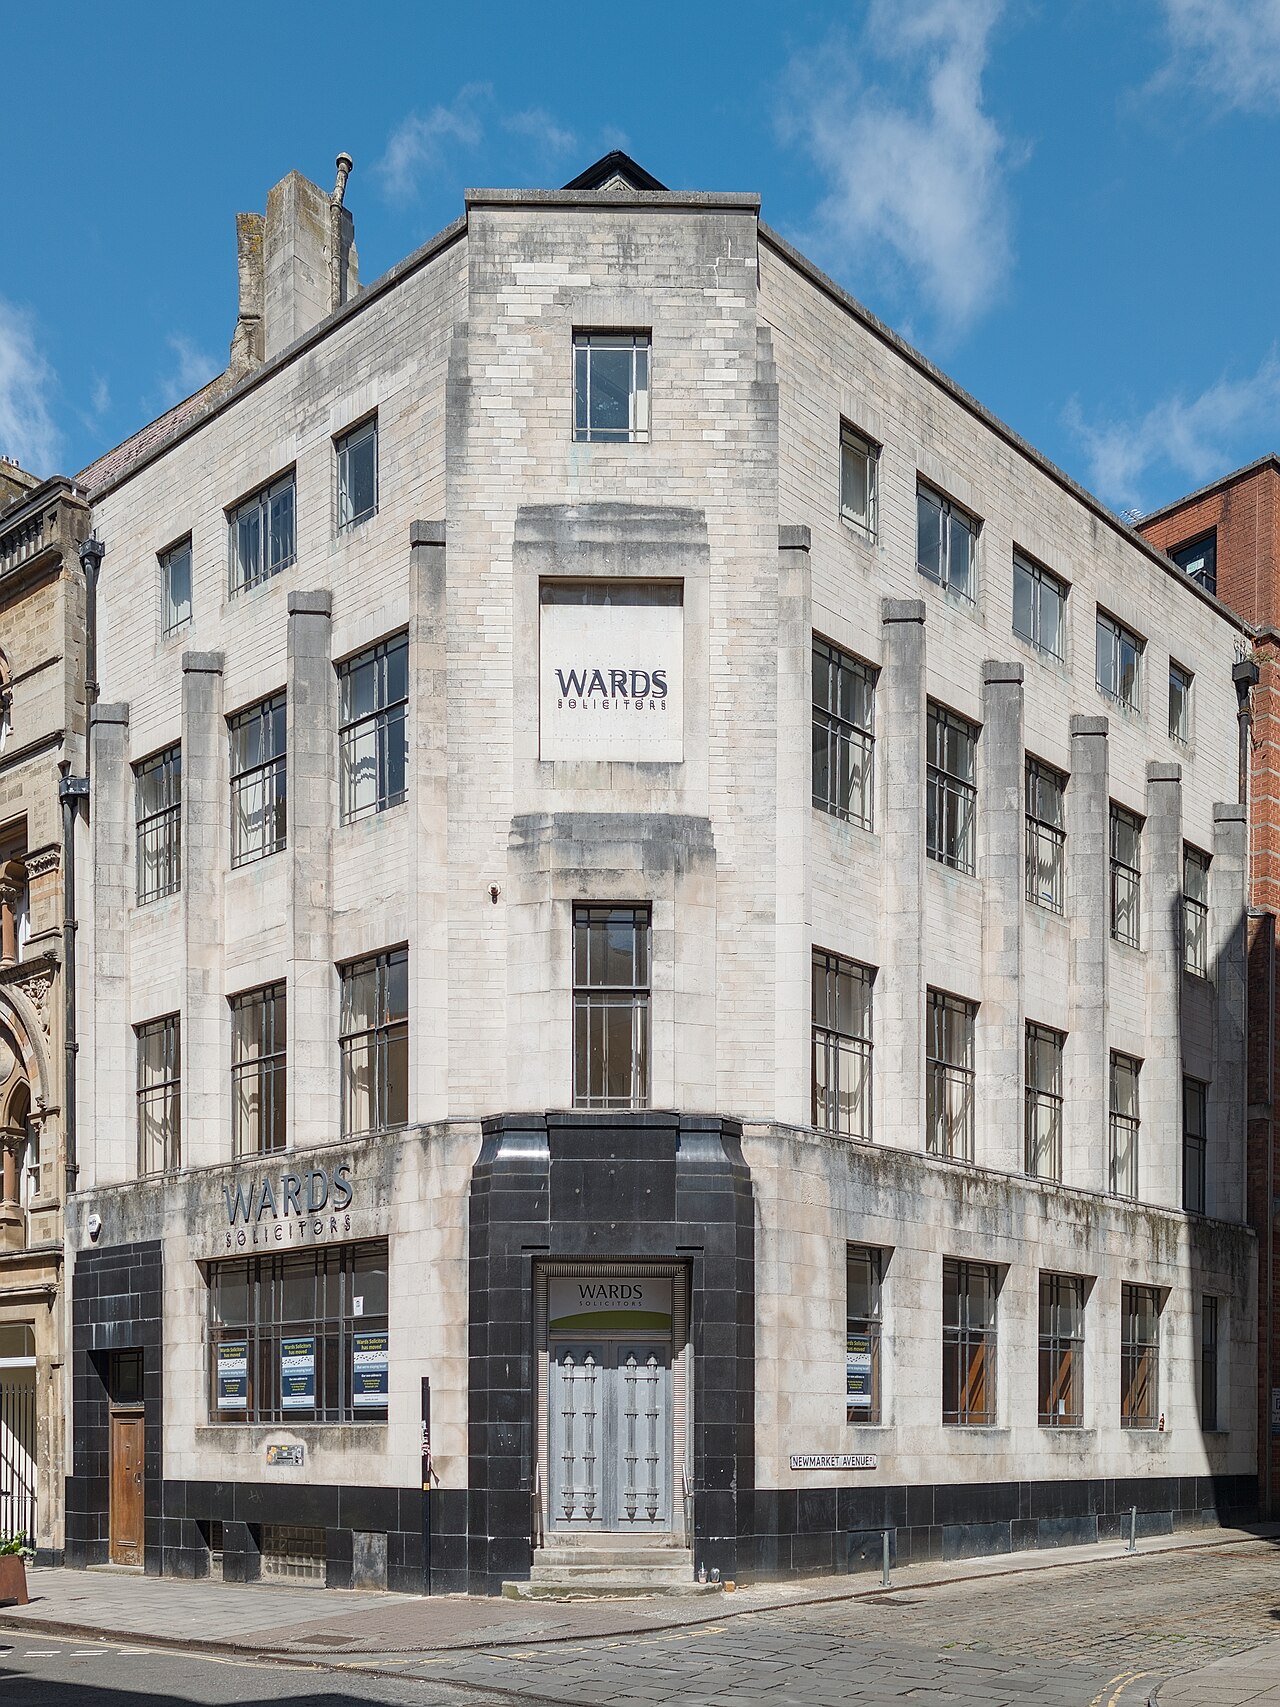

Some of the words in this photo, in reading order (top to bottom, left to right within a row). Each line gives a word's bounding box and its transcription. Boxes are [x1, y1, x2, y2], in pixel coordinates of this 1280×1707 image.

[554, 669, 668, 698] WARDS
[557, 699, 666, 710] SOLICITORS
[222, 1163, 353, 1225] WARDS
[226, 1214, 351, 1248] SOLICITORS
[578, 1284, 643, 1299] WARDS
[792, 1456, 840, 1467] NEWMARKET
[842, 1456, 869, 1466] AVENUE
